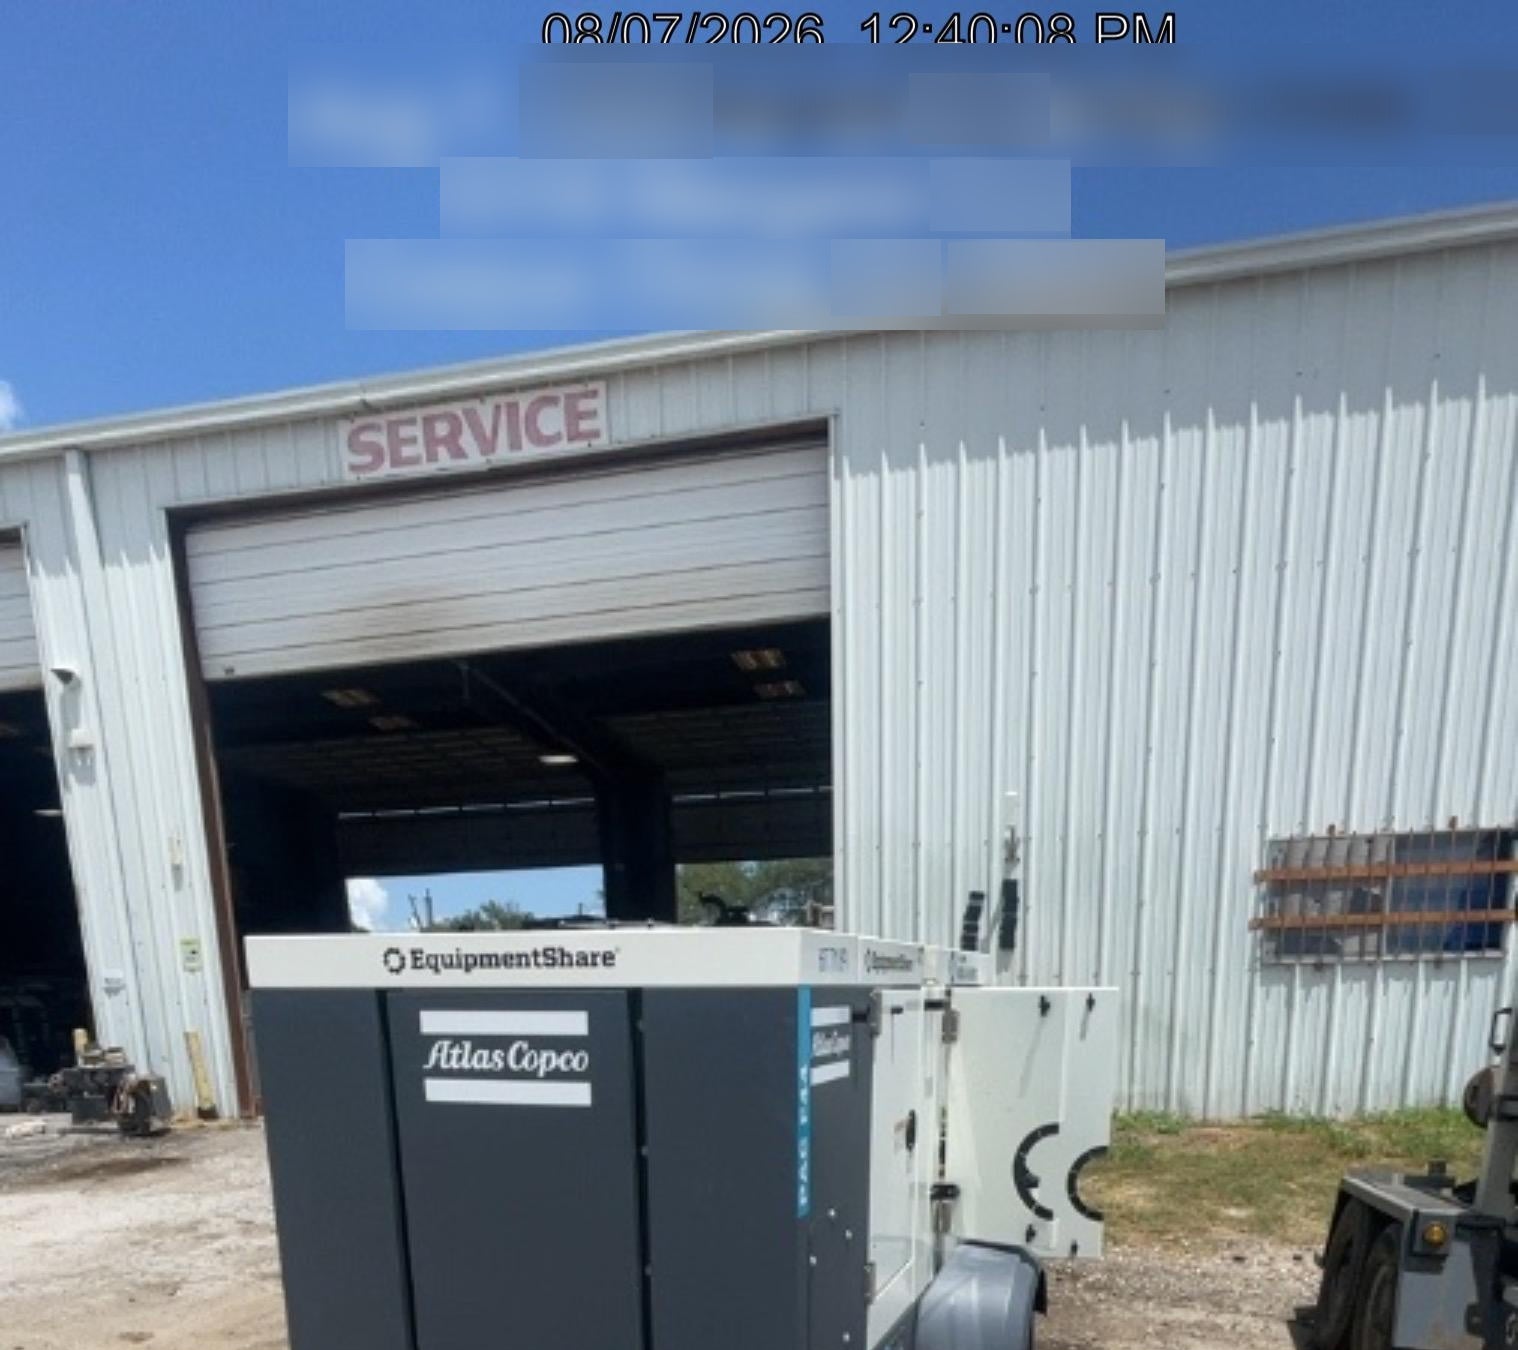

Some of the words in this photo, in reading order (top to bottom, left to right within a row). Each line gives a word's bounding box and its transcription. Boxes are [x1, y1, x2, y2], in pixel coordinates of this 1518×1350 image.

[348, 389, 600, 474] SERVICE
[410, 947, 614, 974] EquipmentShare
[423, 1040, 504, 1070] Atlas
[506, 1040, 589, 1077] Copco
